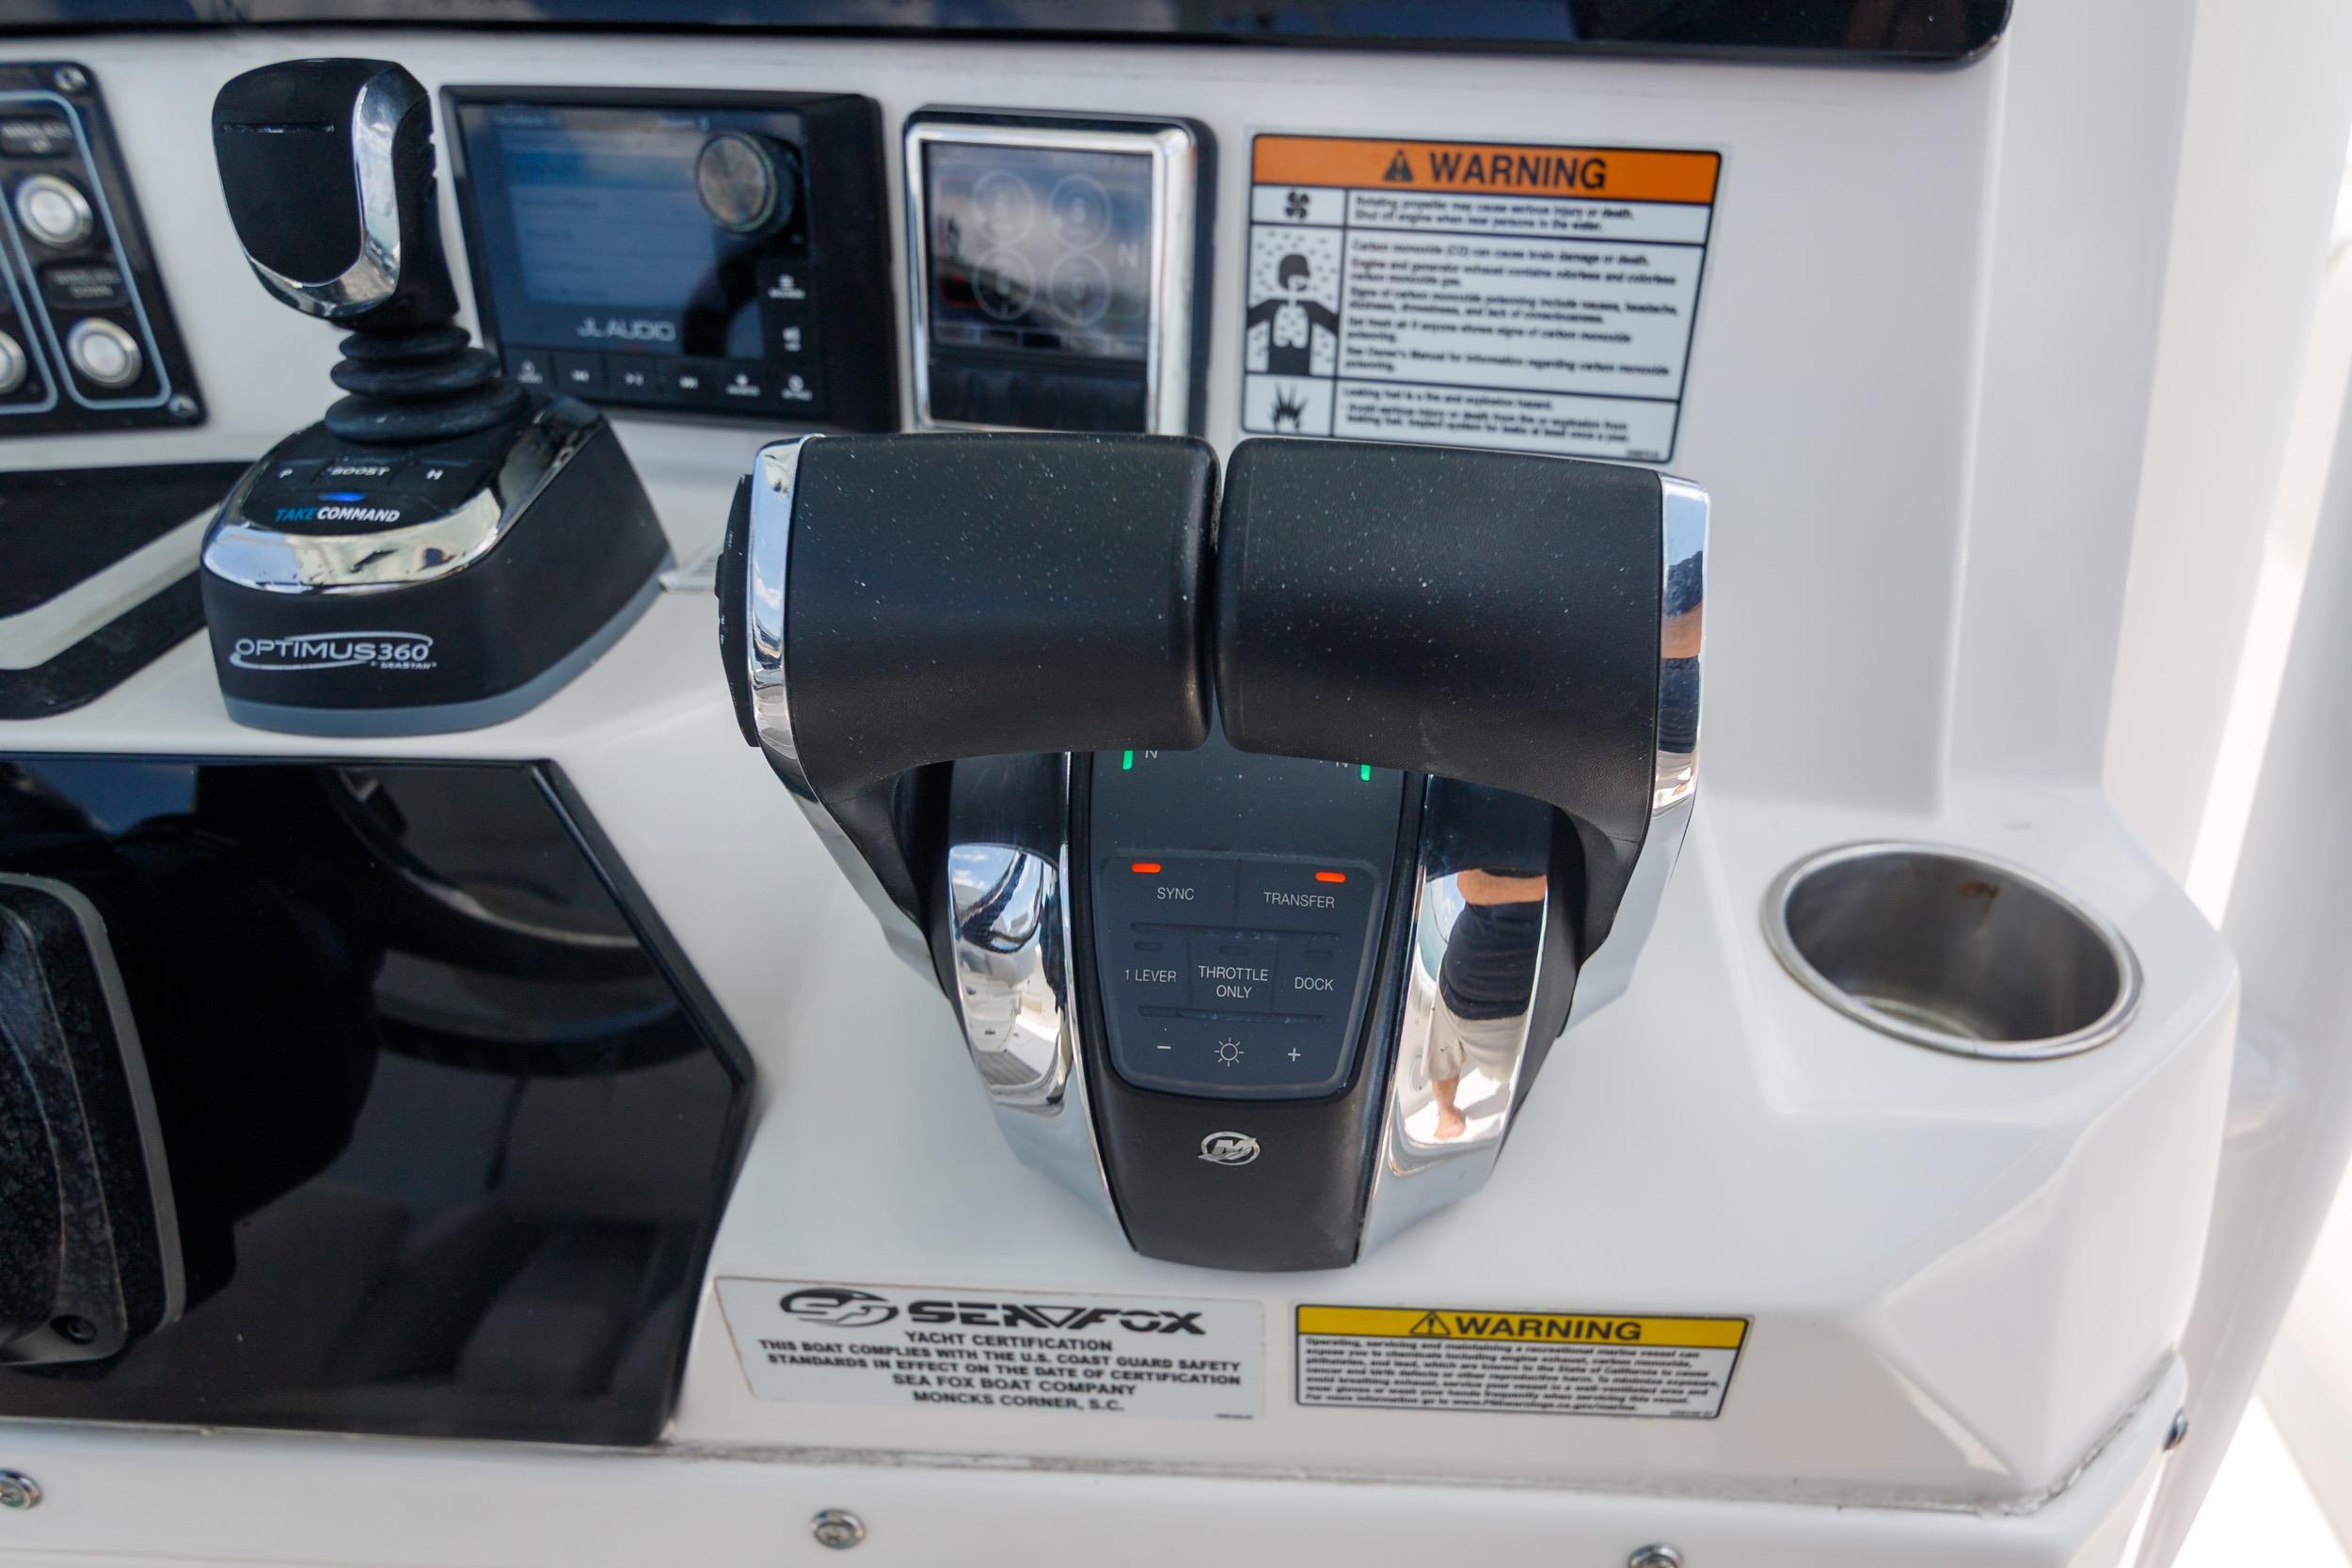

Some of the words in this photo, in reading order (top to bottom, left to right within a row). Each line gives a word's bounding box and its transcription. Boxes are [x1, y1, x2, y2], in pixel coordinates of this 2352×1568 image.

[1430, 152, 1606, 189] WARNING
[607, 319, 676, 341] AUDIO
[330, 466, 390, 476] BOOST
[1157, 887, 1195, 900] SYNC
[1263, 892, 1335, 909] TRANSFER
[1124, 970, 1130, 981] 1
[1135, 970, 1177, 983] LEVER
[1198, 966, 1268, 981] THROTTLE
[1295, 976, 1334, 990] DOCK
[1216, 985, 1252, 998] ONLY
[1455, 1316, 1642, 1341] WARNING
[904, 1331, 965, 1344] YACHT
[972, 1334, 1112, 1351] CERTIFICATION
[758, 1339, 797, 1351] THIS
[802, 1341, 842, 1353] BOAT
[849, 1343, 930, 1357] COMPLIES
[936, 1347, 977, 1359] WITH
[986, 1350, 1014, 1361] THE
[1021, 1352, 1051, 1363] U.S.
[1057, 1353, 1109, 1366] COAST
[1116, 1355, 1172, 1369] GUARD
[1178, 1358, 1240, 1371] SAFETY
[768, 1354, 867, 1368] STANDARDS
[873, 1358, 890, 1369] IN
[897, 1359, 958, 1371] EFFECT
[965, 1362, 989, 1373] ON
[996, 1364, 1027, 1375] THE
[1035, 1366, 1076, 1377] DATE
[1083, 1368, 1104, 1378] OF
[1110, 1370, 1240, 1385] CERTIFICATION
[892, 1373, 930, 1386] SEA
[936, 1375, 973, 1387] FOX
[980, 1377, 1031, 1390] BOAT
[1039, 1380, 1135, 1395] COMPANY
[913, 1391, 993, 1404] MONCKS
[1000, 1394, 1083, 1409] CORNER,
[1089, 1398, 1123, 1410] S.C.
